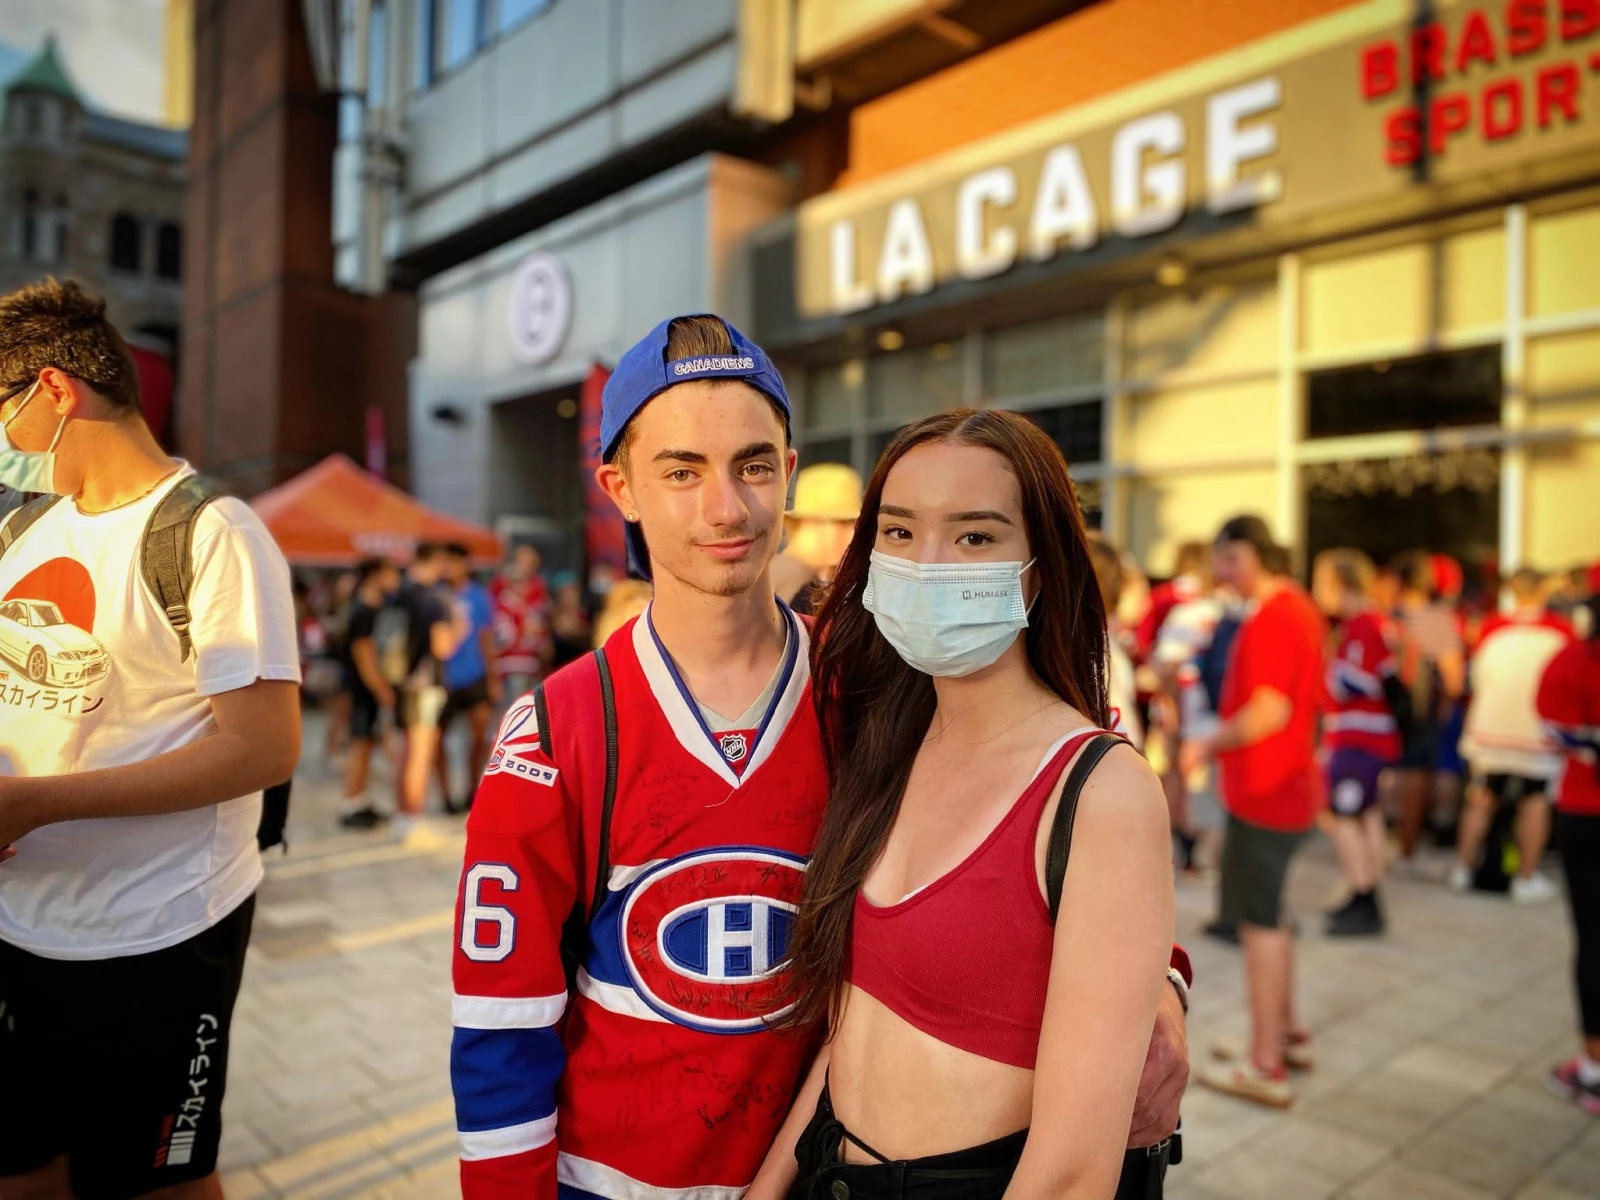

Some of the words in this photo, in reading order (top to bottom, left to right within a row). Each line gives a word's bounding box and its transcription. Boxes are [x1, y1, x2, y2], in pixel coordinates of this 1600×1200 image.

[829, 199, 936, 315] LA
[955, 77, 1283, 282] CAGE
[674, 357, 755, 375] CANADIENS
[505, 759, 553, 781] 2009
[459, 861, 521, 963] 6
[176, 1013, 219, 1128] スカイライン
